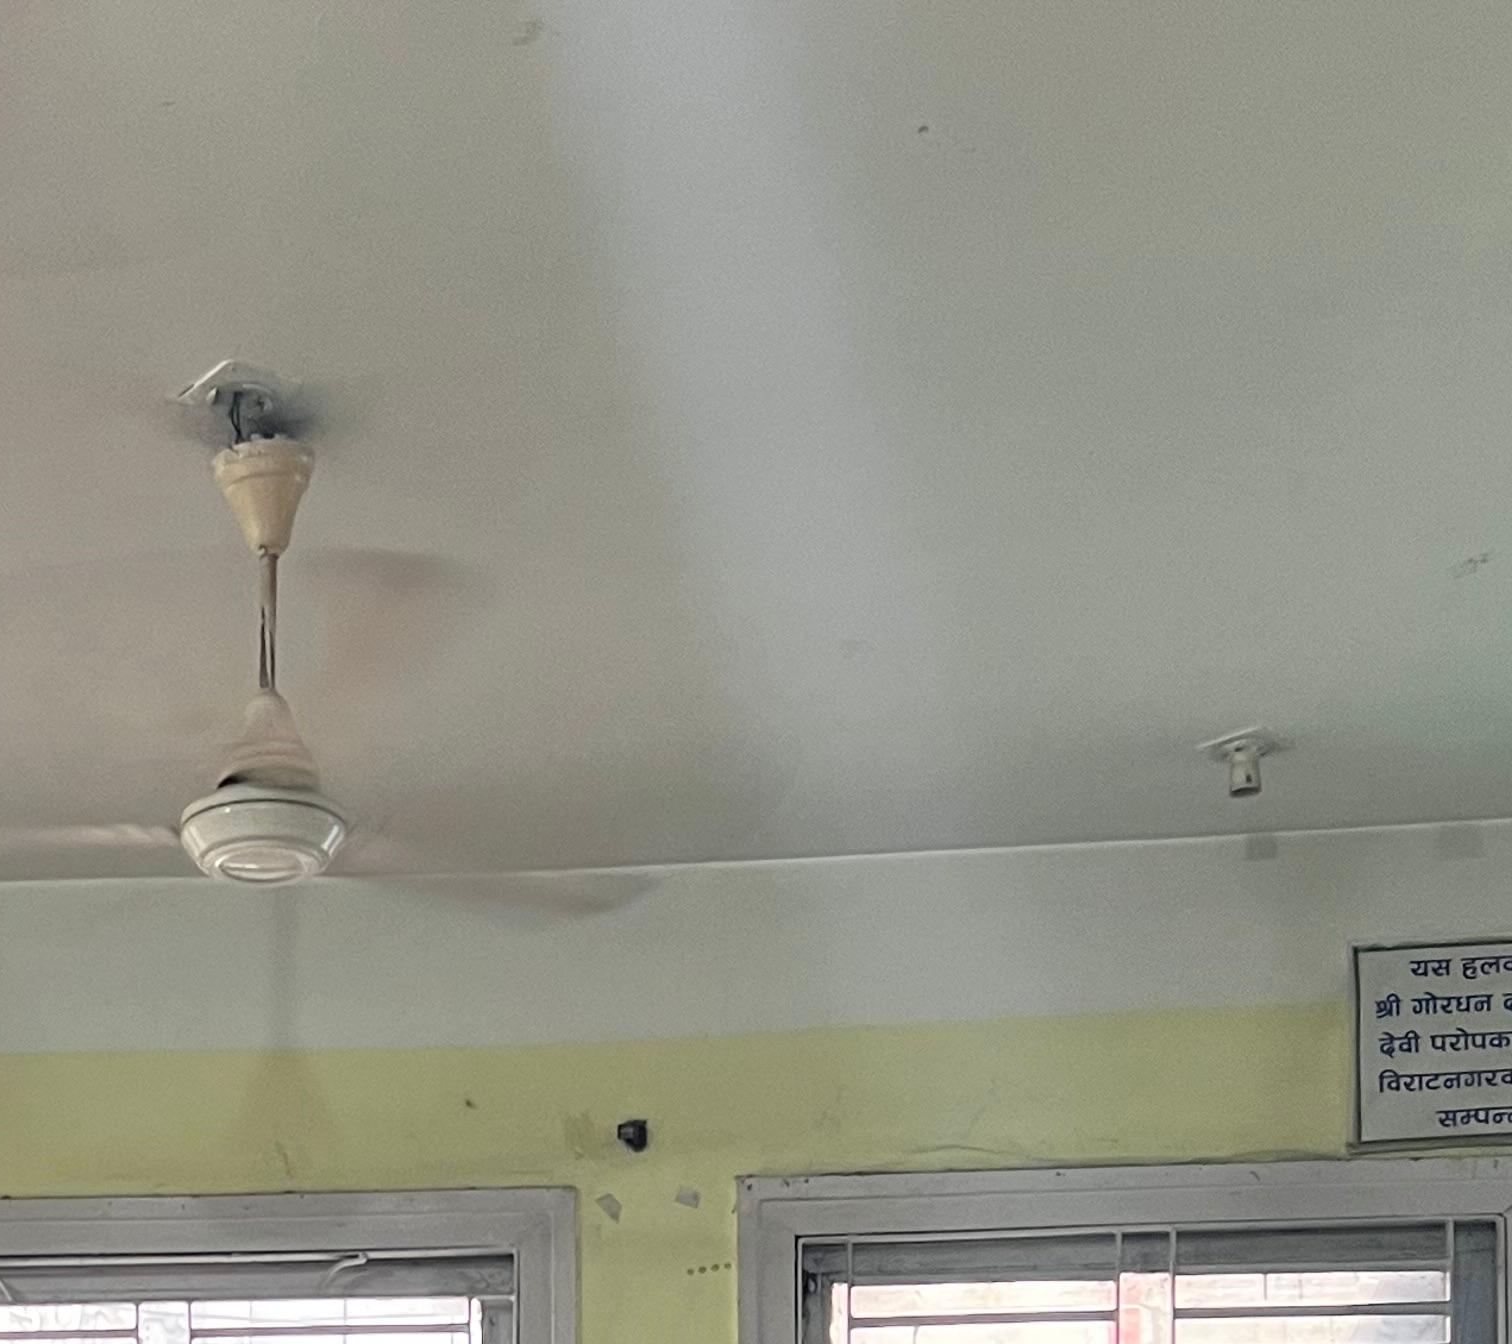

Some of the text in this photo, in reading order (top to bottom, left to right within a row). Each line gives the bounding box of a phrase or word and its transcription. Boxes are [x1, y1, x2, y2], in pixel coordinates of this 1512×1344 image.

[1410, 958, 1452, 977] यस
[1375, 993, 1401, 1019] श्री
[1411, 992, 1493, 1015] गोरधन
[1379, 1030, 1421, 1058] देवी
